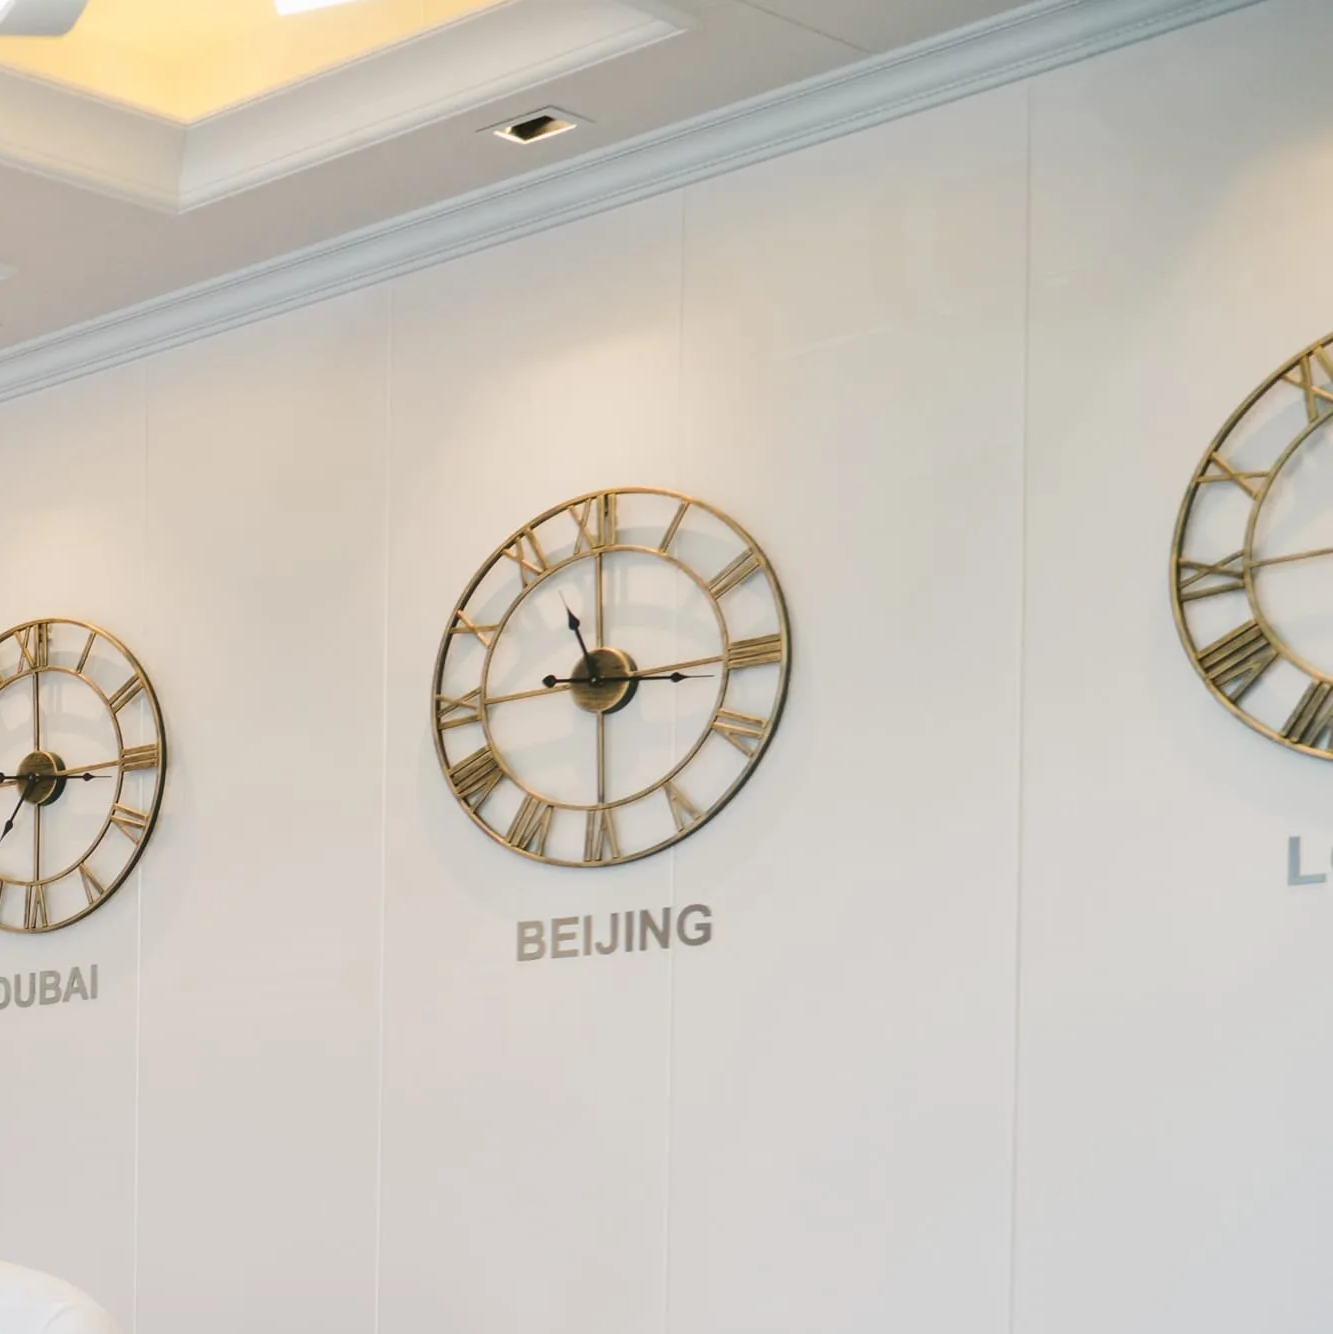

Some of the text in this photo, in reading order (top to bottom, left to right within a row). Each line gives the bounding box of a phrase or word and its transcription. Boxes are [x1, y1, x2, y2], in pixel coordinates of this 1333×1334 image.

[1194, 450, 1271, 501] X
[568, 492, 616, 556] XII
[658, 500, 691, 554] I
[502, 528, 549, 590] XI
[706, 546, 763, 601] II
[449, 608, 502, 649] X
[727, 632, 784, 670] III
[435, 687, 483, 731] IX
[710, 707, 771, 759] IV
[449, 744, 505, 813] VIII
[506, 794, 554, 857] VII
[664, 779, 705, 834] V
[583, 808, 620, 862] VI
[1287, 836, 1333, 887] L
[516, 903, 713, 962] BEIJING
